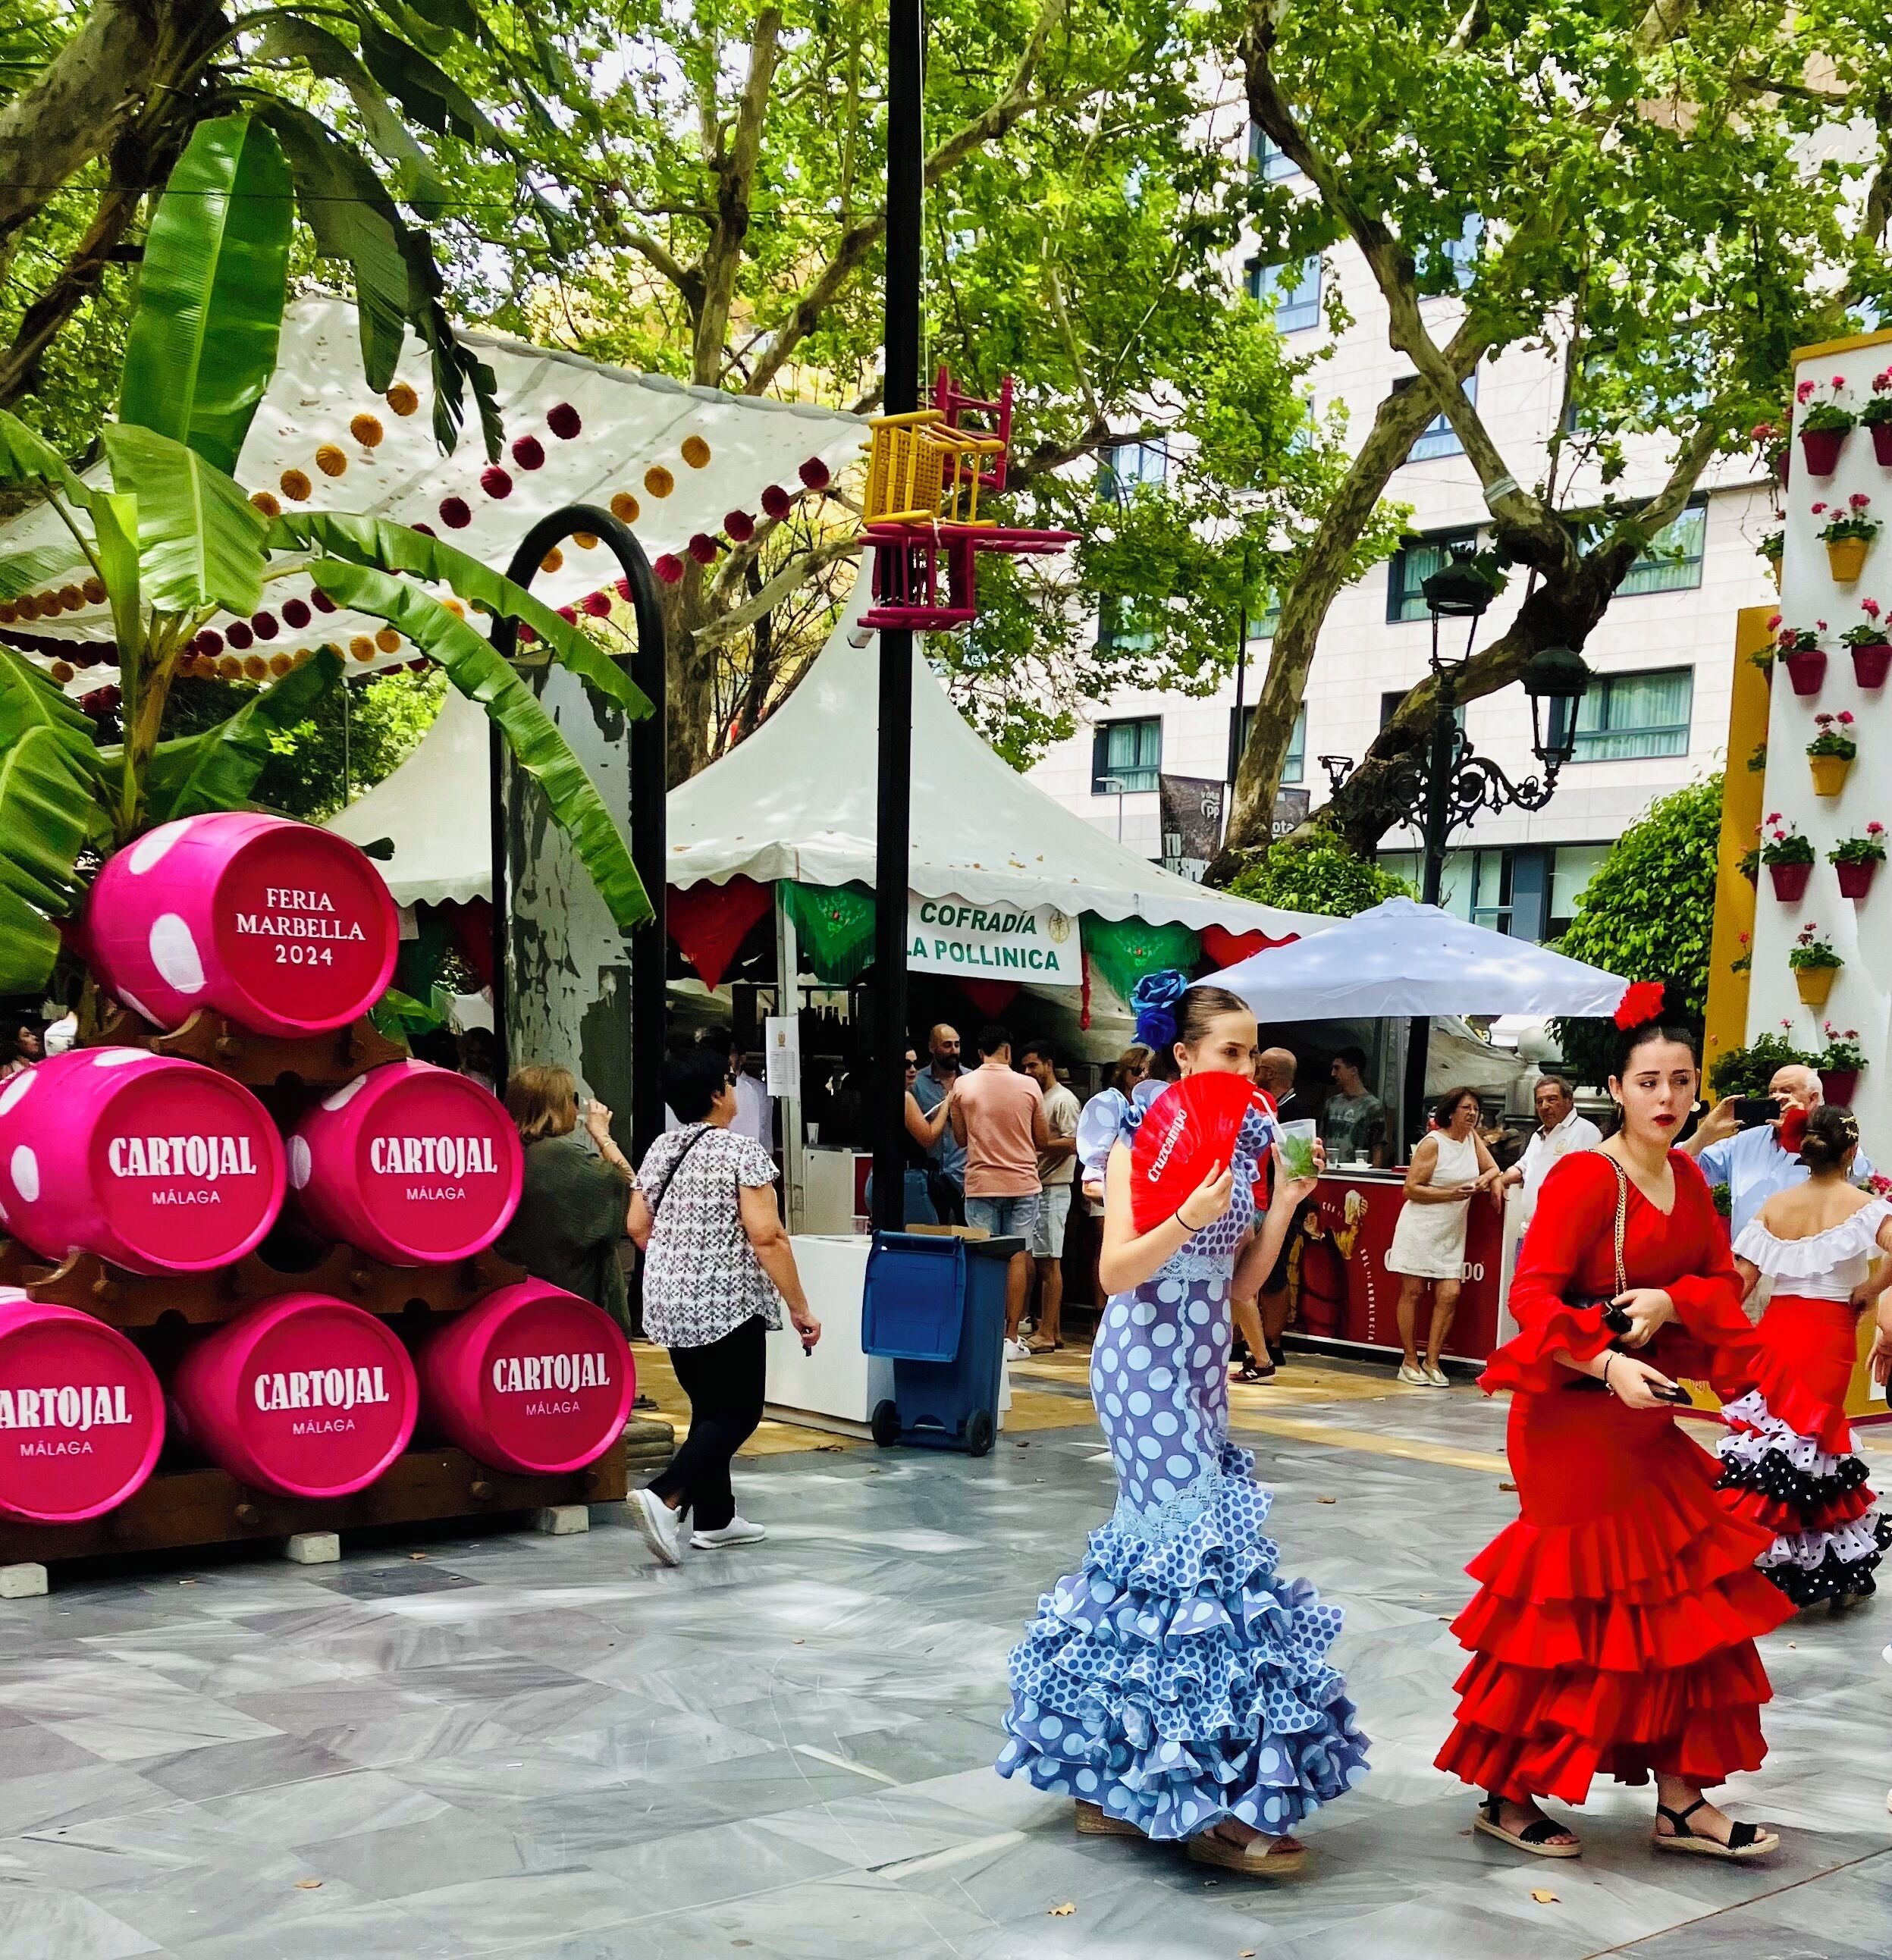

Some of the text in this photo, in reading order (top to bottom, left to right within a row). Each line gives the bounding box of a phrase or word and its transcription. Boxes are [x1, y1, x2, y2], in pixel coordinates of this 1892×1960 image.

[1200, 791, 1220, 801] vota
[266, 888, 336, 911] FERIA
[236, 913, 366, 941] MARBELLA
[920, 902, 1037, 935] COFRADÍA
[275, 944, 334, 966] 2024
[908, 937, 1060, 971] A POLLINICA
[108, 1135, 257, 1181] CARTOJAL
[370, 1136, 498, 1179] CARTOJAL
[1147, 1109, 1188, 1182] Cruzcampo
[152, 1189, 221, 1205] MÁLAGA
[406, 1186, 466, 1200] MÁLAGA
[493, 1353, 610, 1394] CARTOJAL
[254, 1366, 390, 1411] CARTOJAL
[0, 1385, 133, 1432] ARTOJAL
[526, 1401, 580, 1415] MÁLAGA
[293, 1419, 355, 1435] MÁLAGA
[20, 1441, 93, 1457] MÁLAGA
